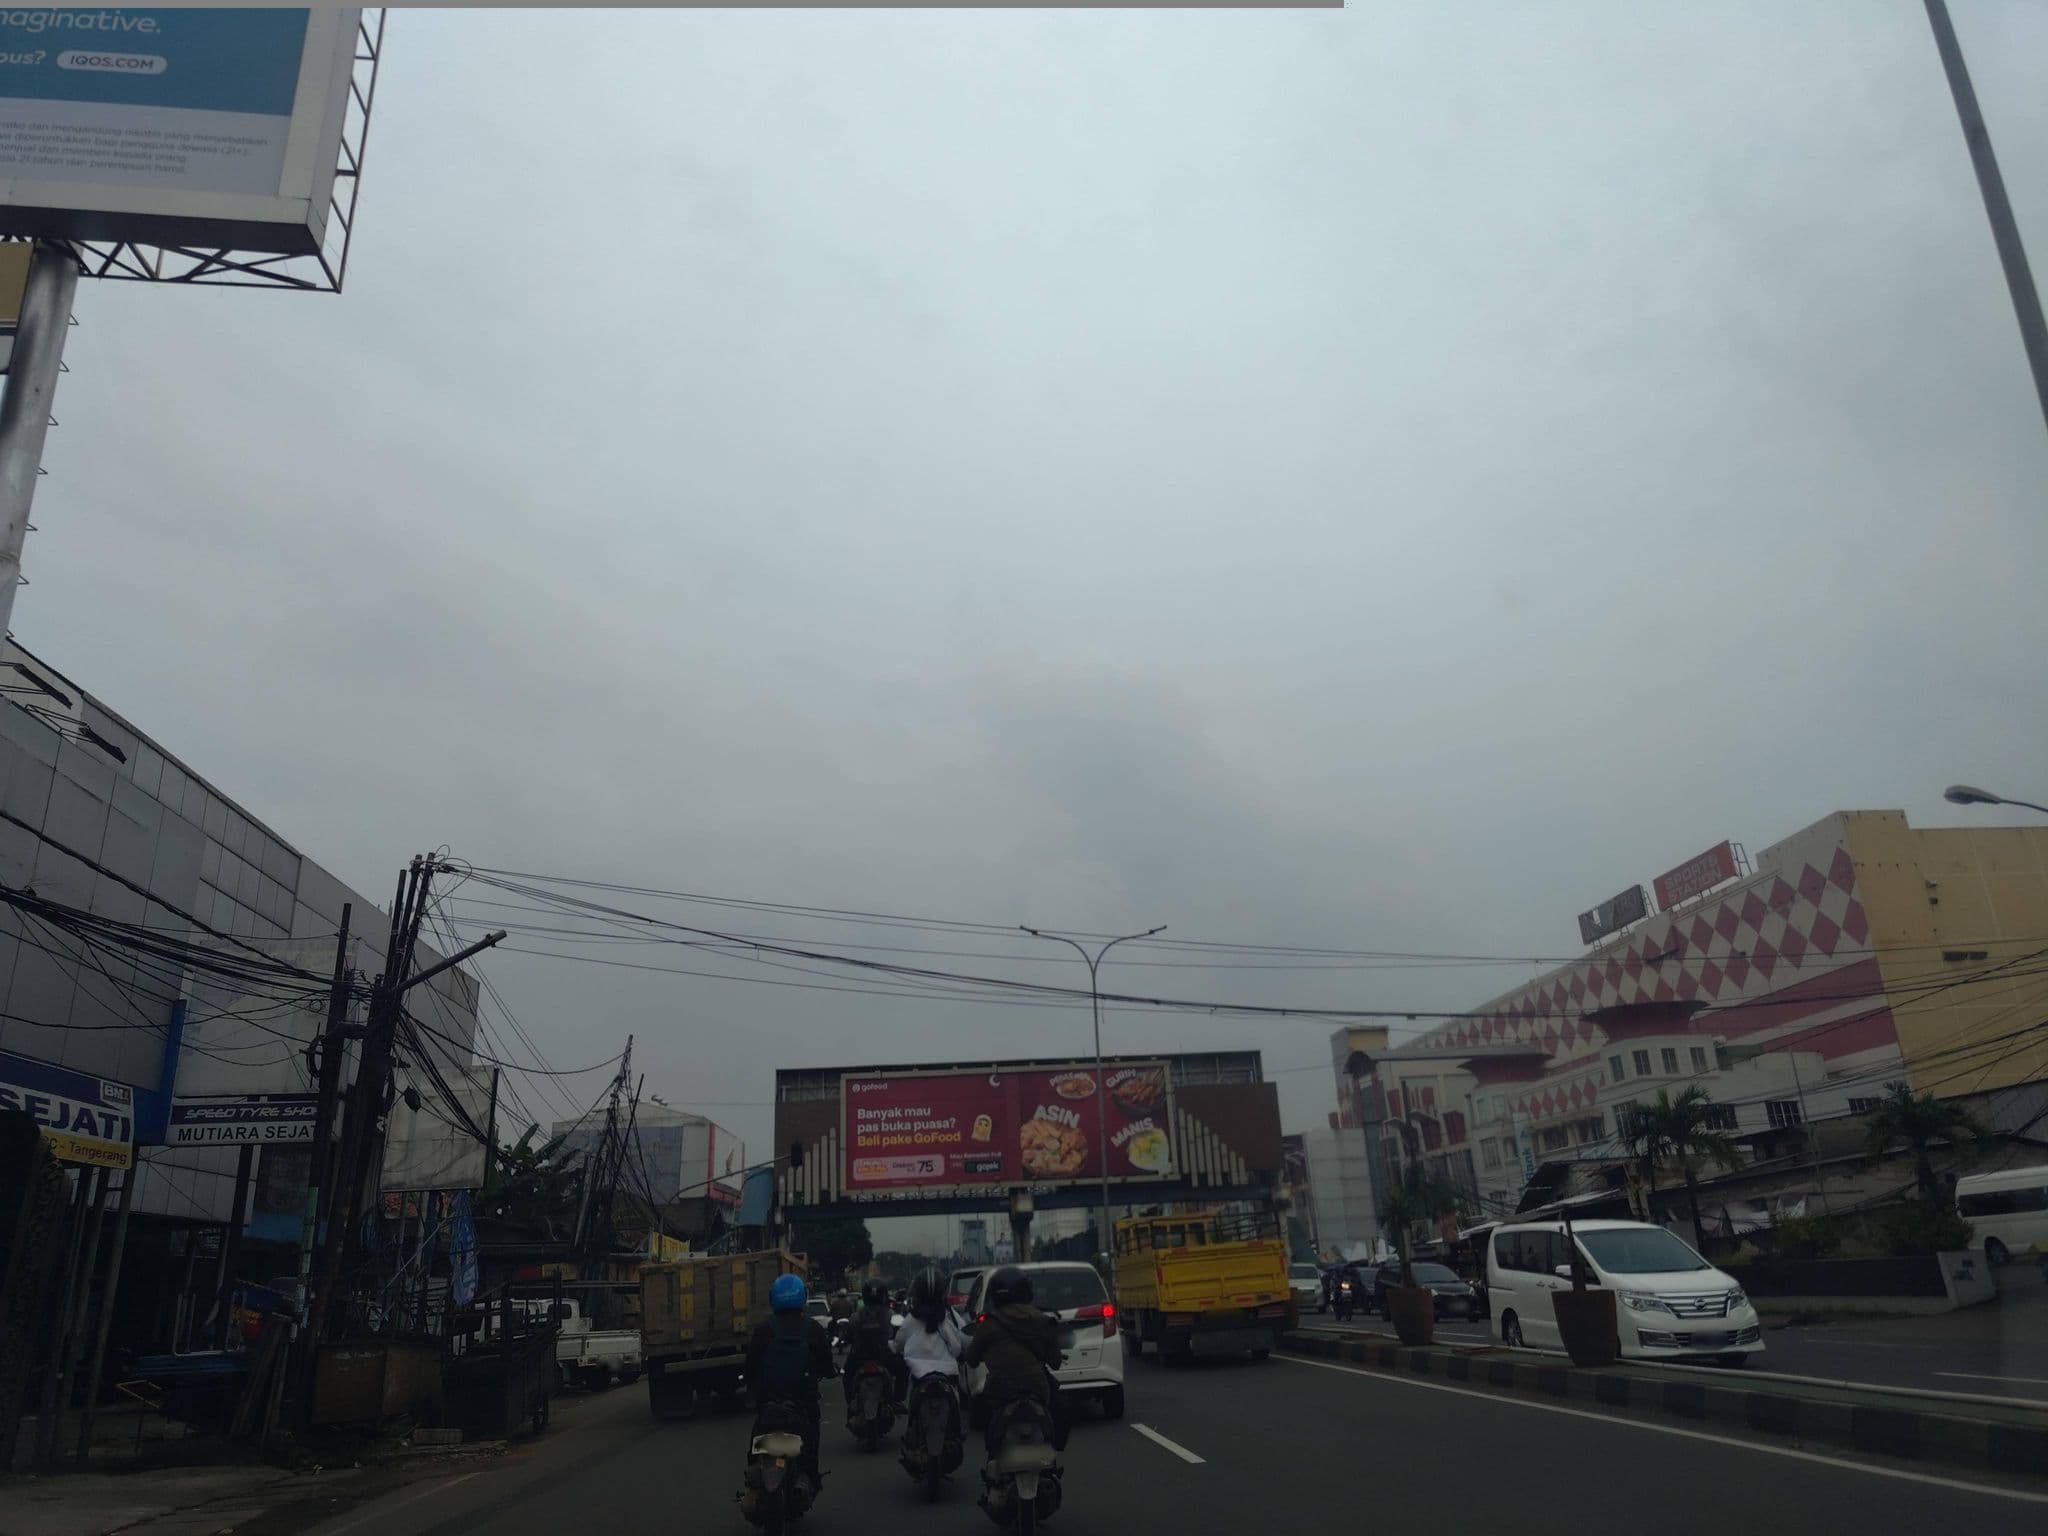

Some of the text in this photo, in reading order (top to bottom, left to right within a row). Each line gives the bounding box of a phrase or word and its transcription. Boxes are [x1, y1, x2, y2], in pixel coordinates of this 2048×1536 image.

[70, 55, 154, 70] IQOS.COM
[184, 1108, 237, 1120] SPEED
[239, 1106, 281, 1119] TYRE
[857, 1106, 932, 1120] Banyak mau
[1033, 1104, 1080, 1129] ASIN
[177, 1126, 260, 1142] MUTIARA
[857, 1117, 957, 1136] pas buka puasa?
[1110, 1117, 1154, 1148] MANIS
[857, 1131, 961, 1149] Beli pake GoFood
[70, 1141, 128, 1165] Tangerang
[917, 1159, 935, 1174] 75
